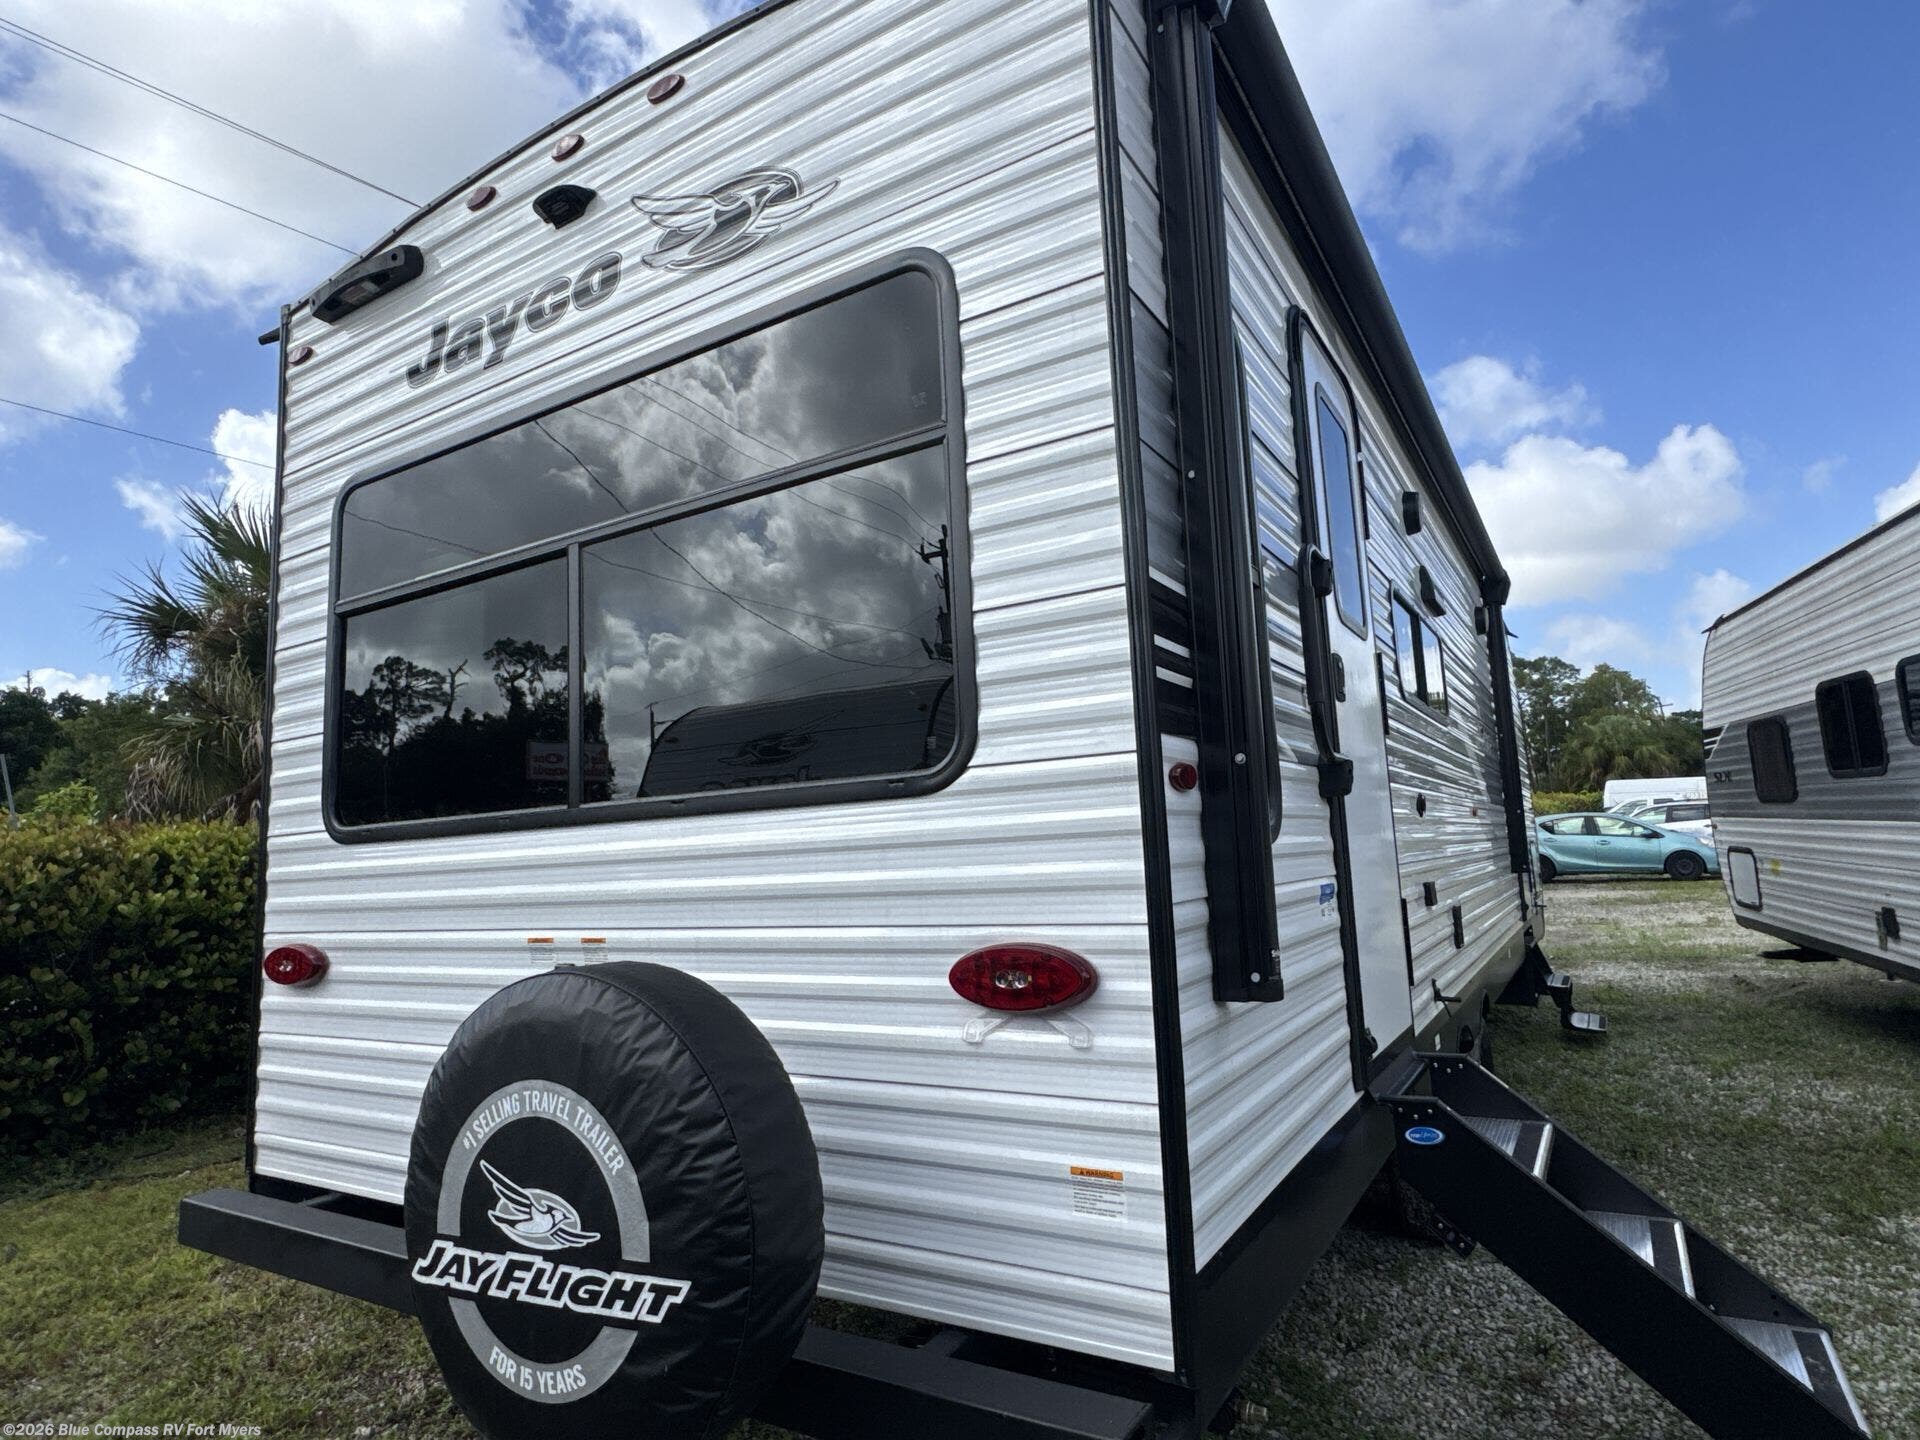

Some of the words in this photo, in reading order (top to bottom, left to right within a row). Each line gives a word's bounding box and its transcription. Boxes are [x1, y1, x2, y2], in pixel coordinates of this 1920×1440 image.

[405, 251, 623, 389] Jayco
[462, 1130, 477, 1150] #1
[473, 1093, 521, 1139] SELLING
[523, 1090, 571, 1121] TRAVEL
[573, 1106, 625, 1176] TRAILER
[489, 1345, 517, 1383] FOR
[520, 1365, 534, 1391] 15
[536, 1364, 587, 1395] YEARS
